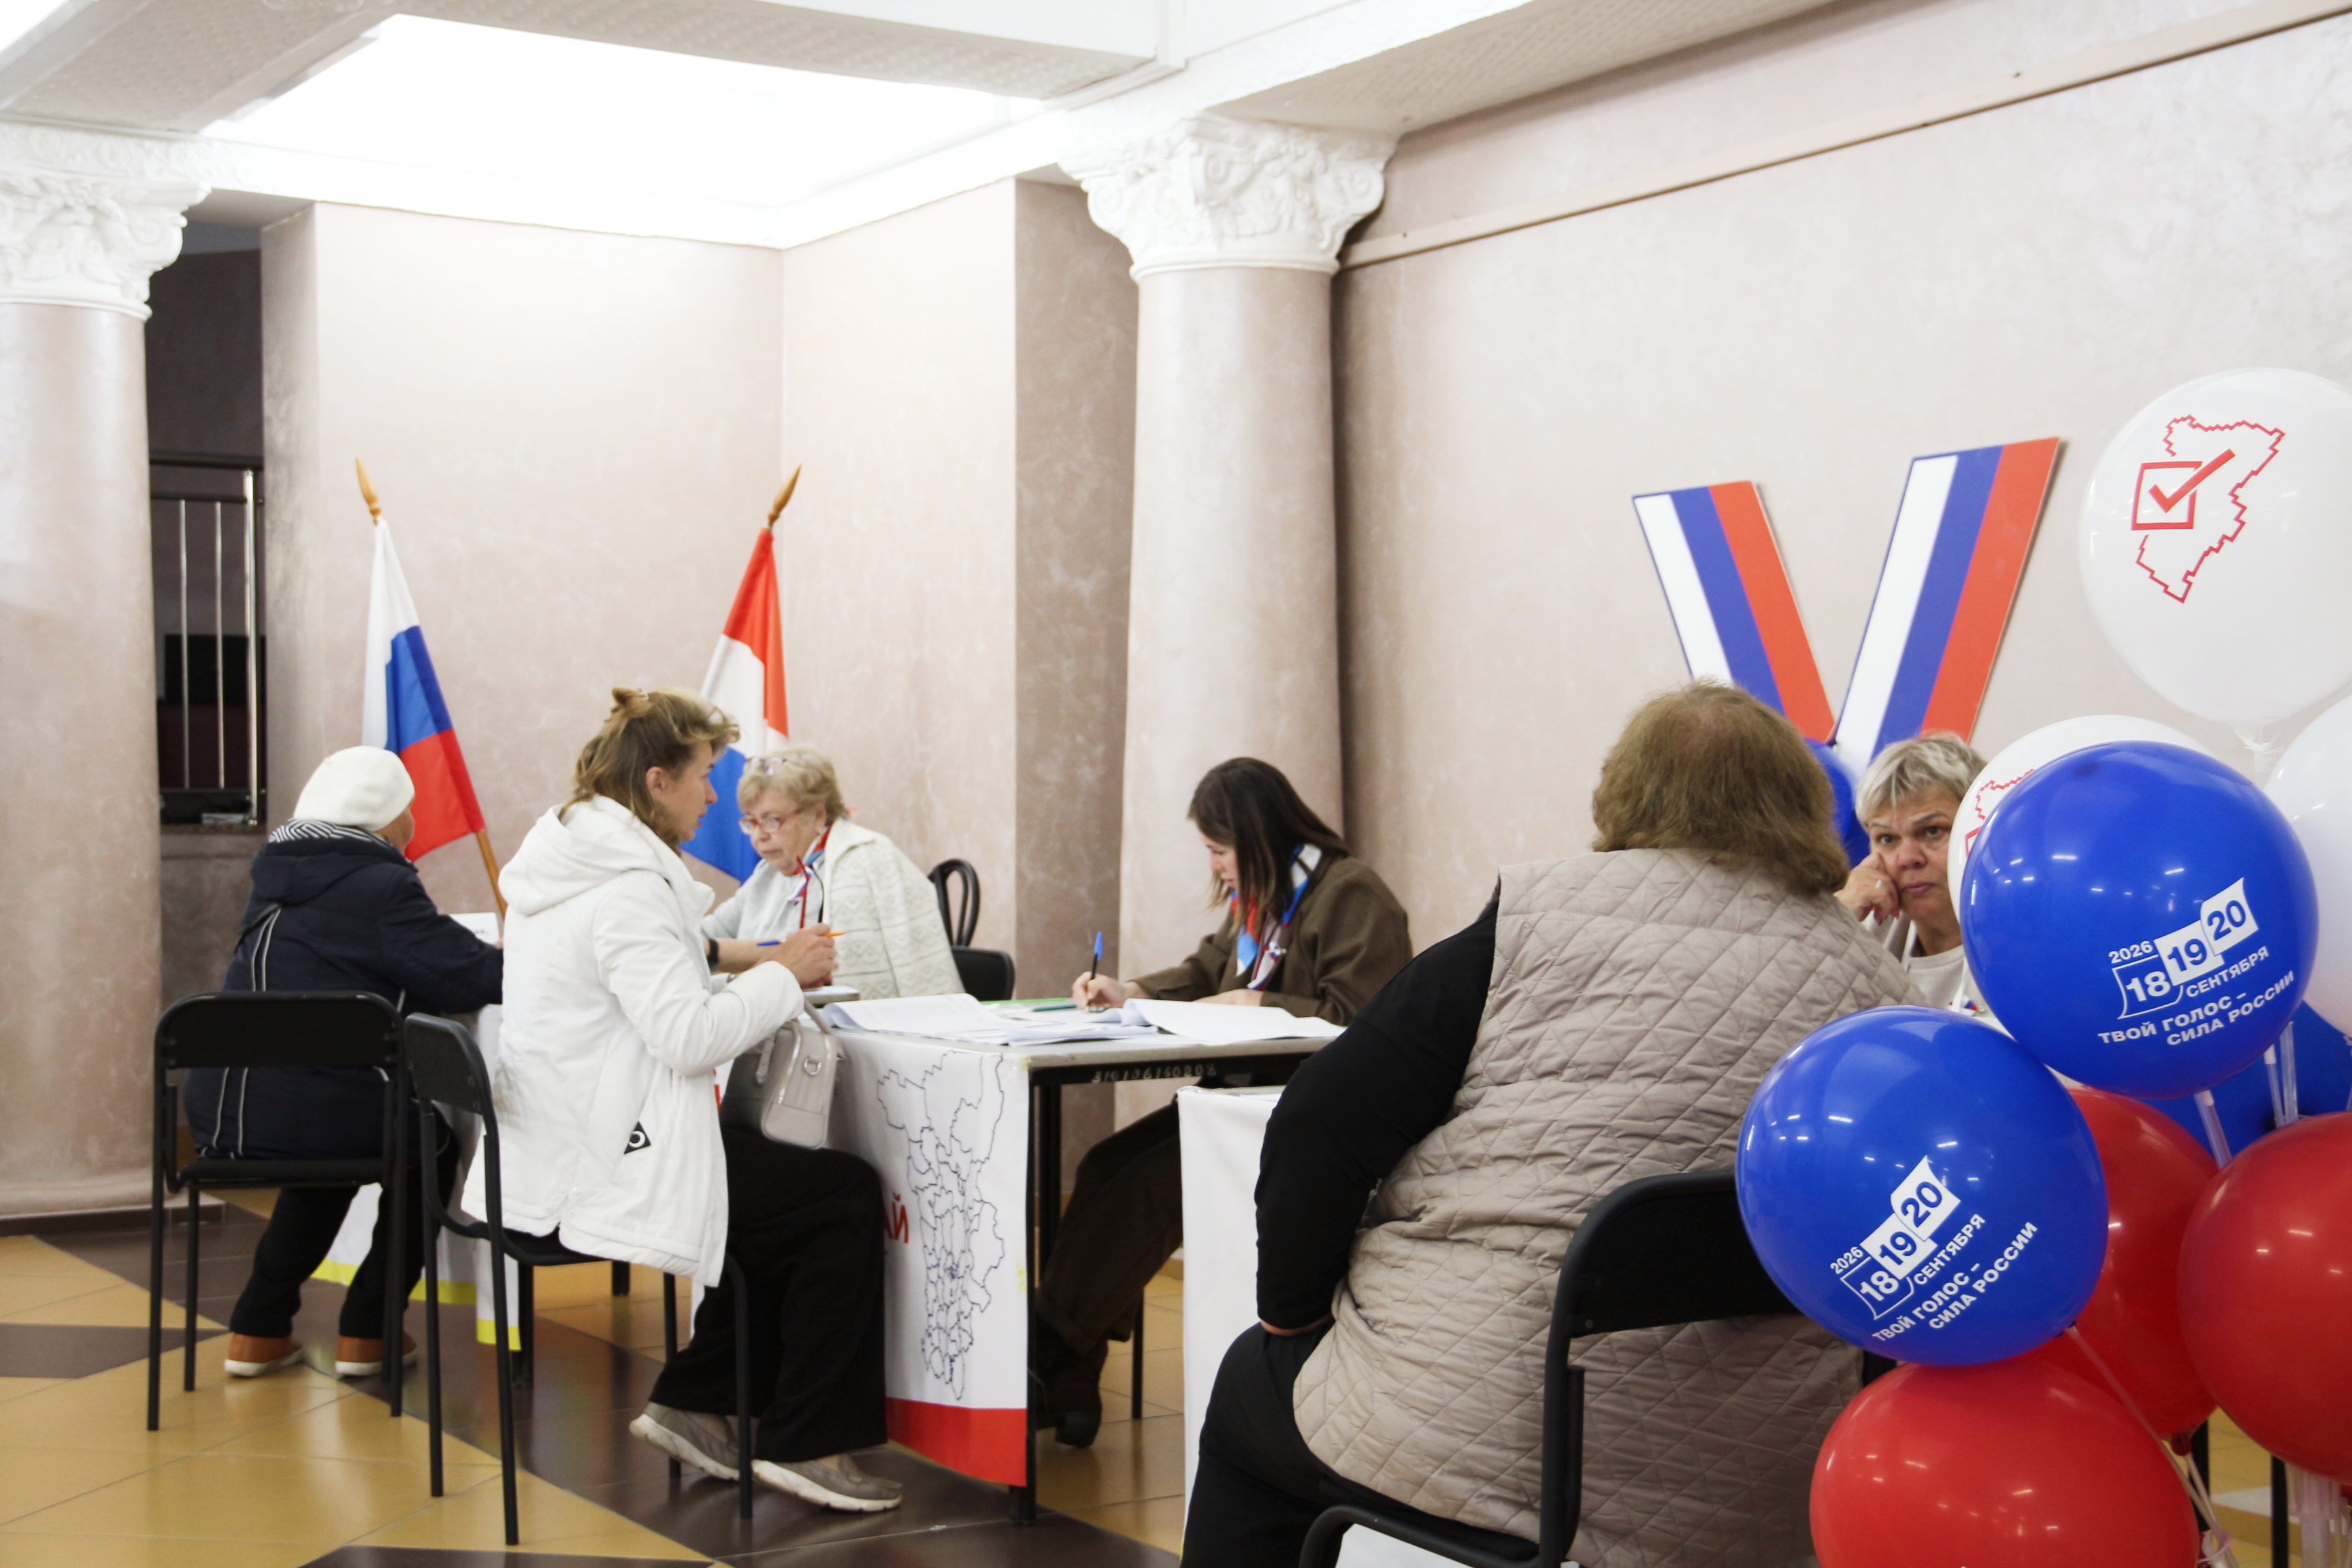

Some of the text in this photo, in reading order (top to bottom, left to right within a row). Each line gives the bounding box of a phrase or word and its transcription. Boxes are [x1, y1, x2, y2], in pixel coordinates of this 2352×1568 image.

[2108, 941, 2153, 964] 2026
[2125, 900, 2247, 1002] 18 19 20
[2186, 945, 2270, 998] СЕНТЯБРЯ
[2097, 1021, 2157, 1043] ТВОЙ
[2161, 996, 2232, 1032] ГОЛОС
[2166, 970, 2295, 1046] СИЛА РОССИИ
[1829, 1246, 1865, 1275] 2026
[1859, 1181, 1942, 1302] 18 19 20
[1913, 1213, 1986, 1286] СЕНТЯБРЯ
[1928, 1222, 2038, 1329] СИЛА РОССИИ
[1872, 1315, 1916, 1341] ТВОЙ
[1912, 1271, 1970, 1320] ГОЛОС
